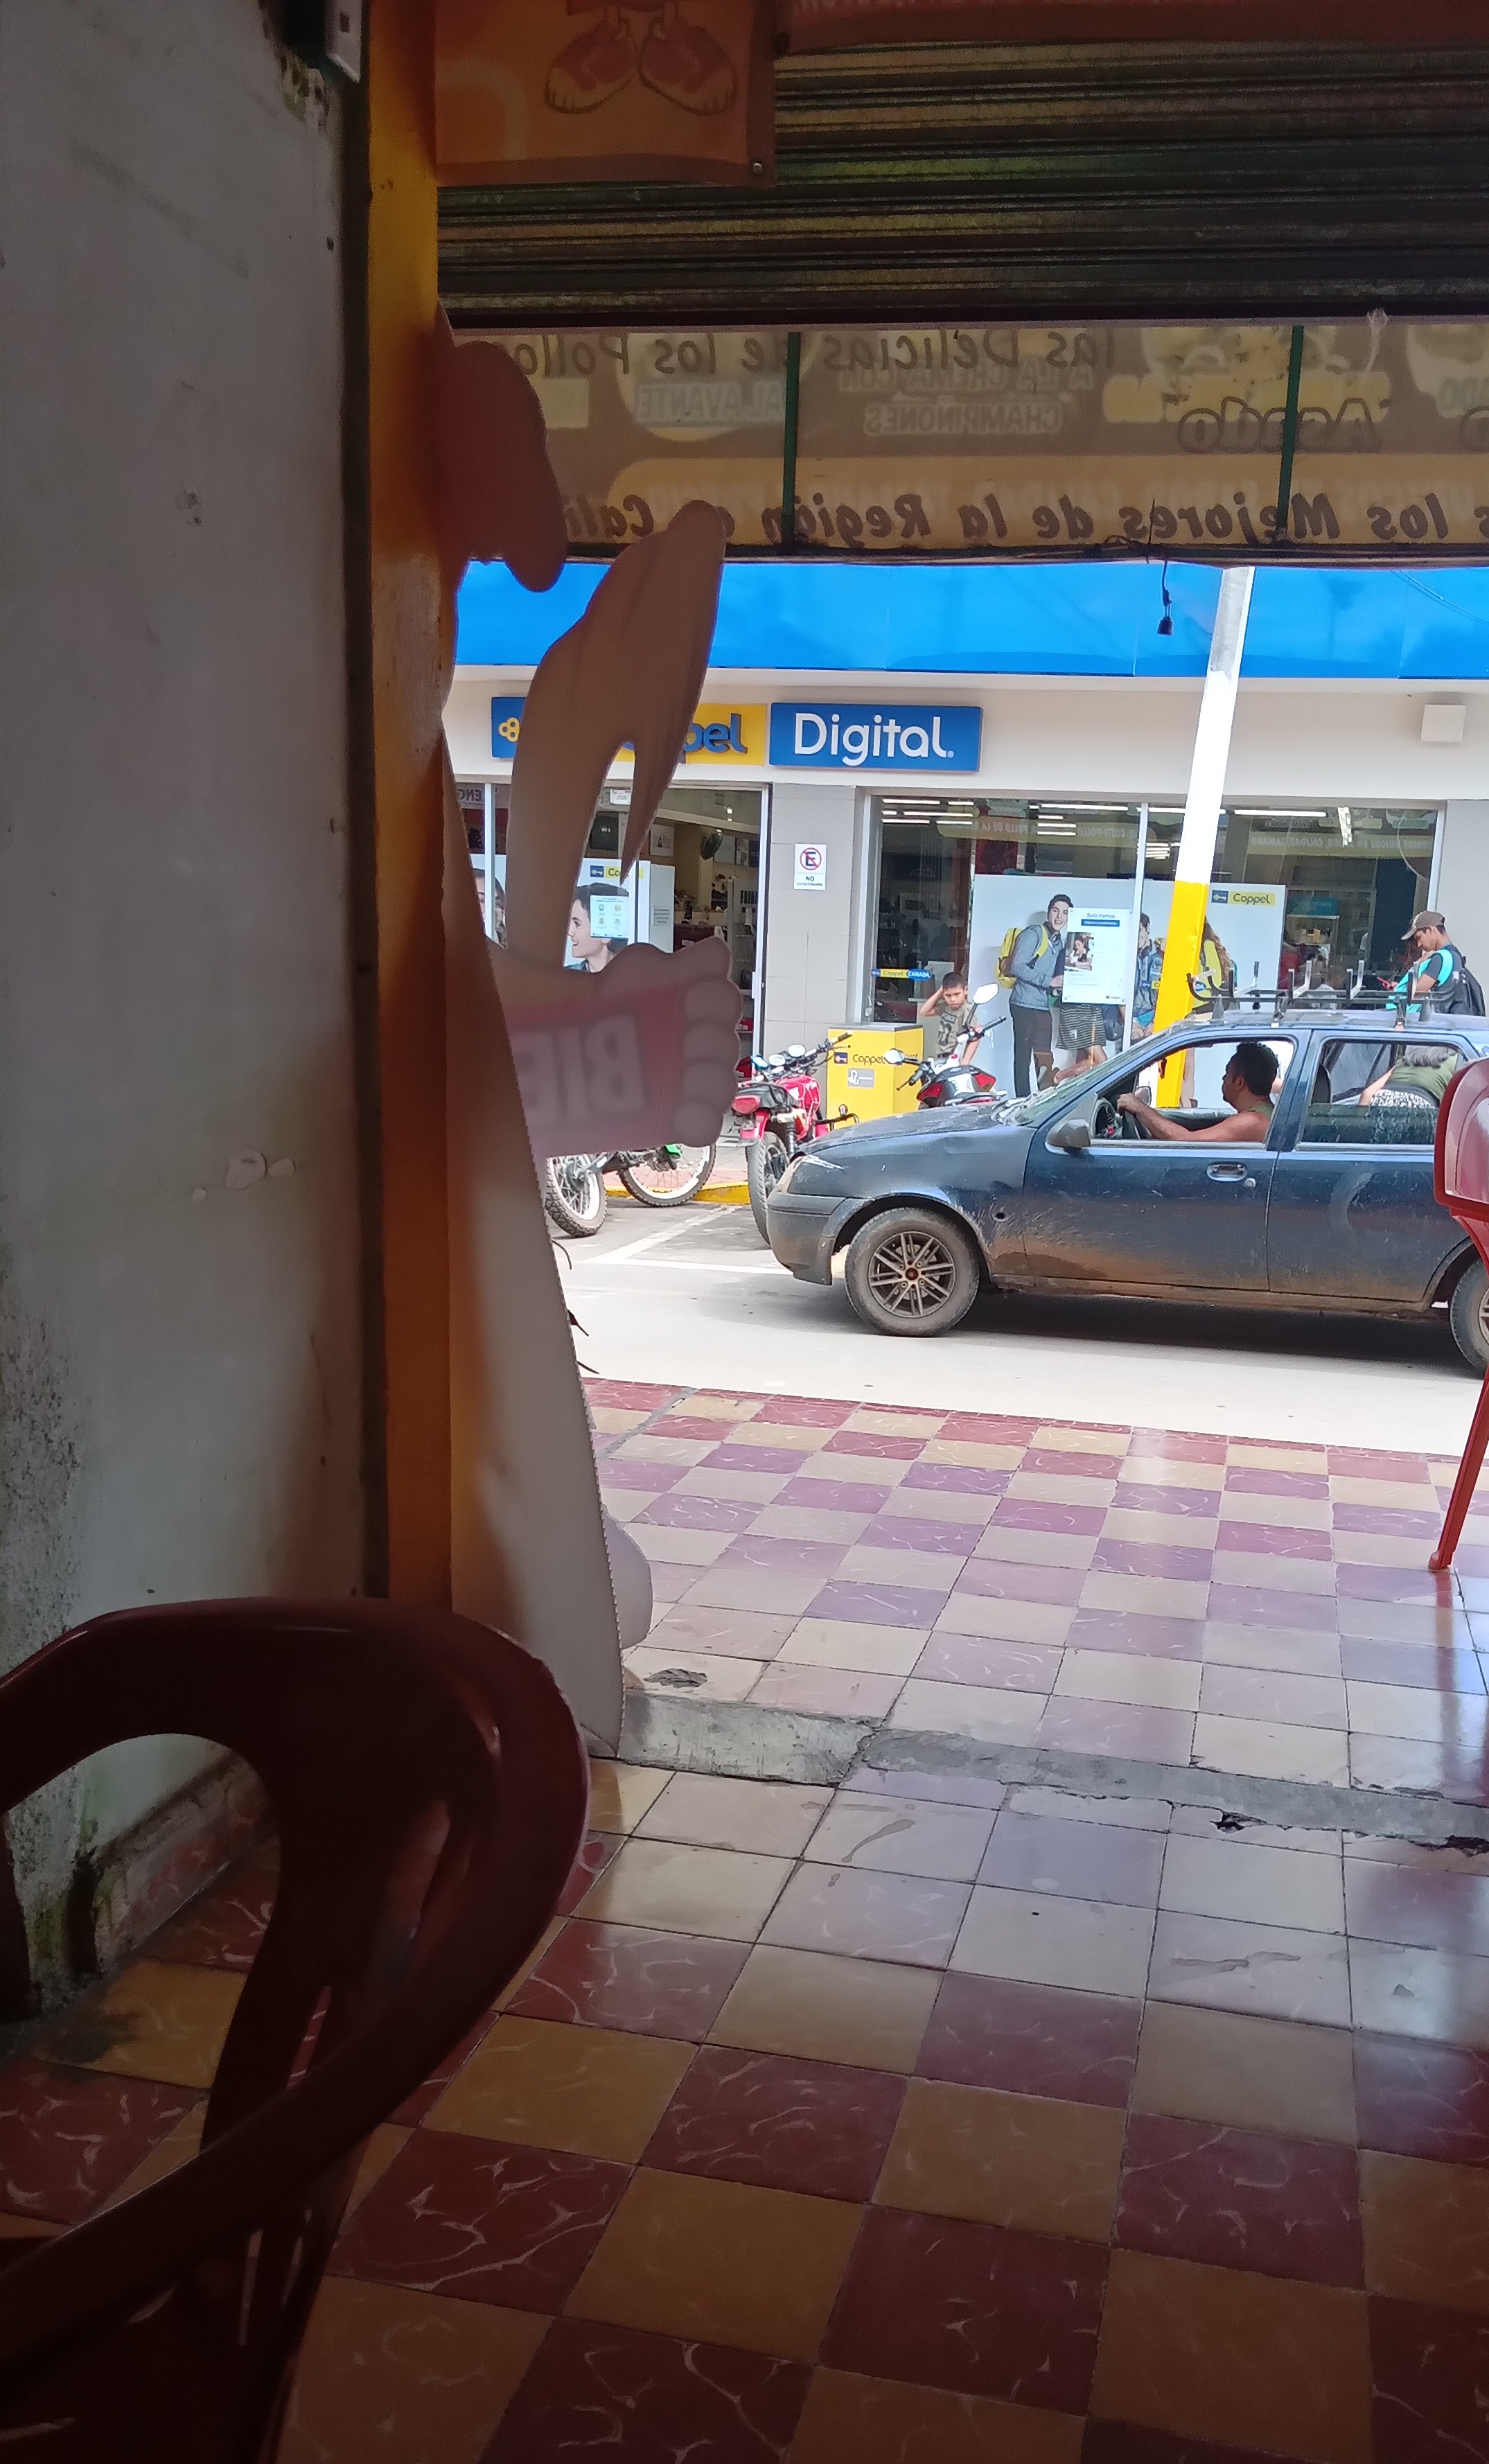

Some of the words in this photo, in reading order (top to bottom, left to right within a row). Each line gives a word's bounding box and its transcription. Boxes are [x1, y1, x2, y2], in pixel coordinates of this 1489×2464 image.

[794, 712, 948, 766] Digital
[1233, 893, 1270, 905] Coppel
[852, 1054, 886, 1066] Coppel
